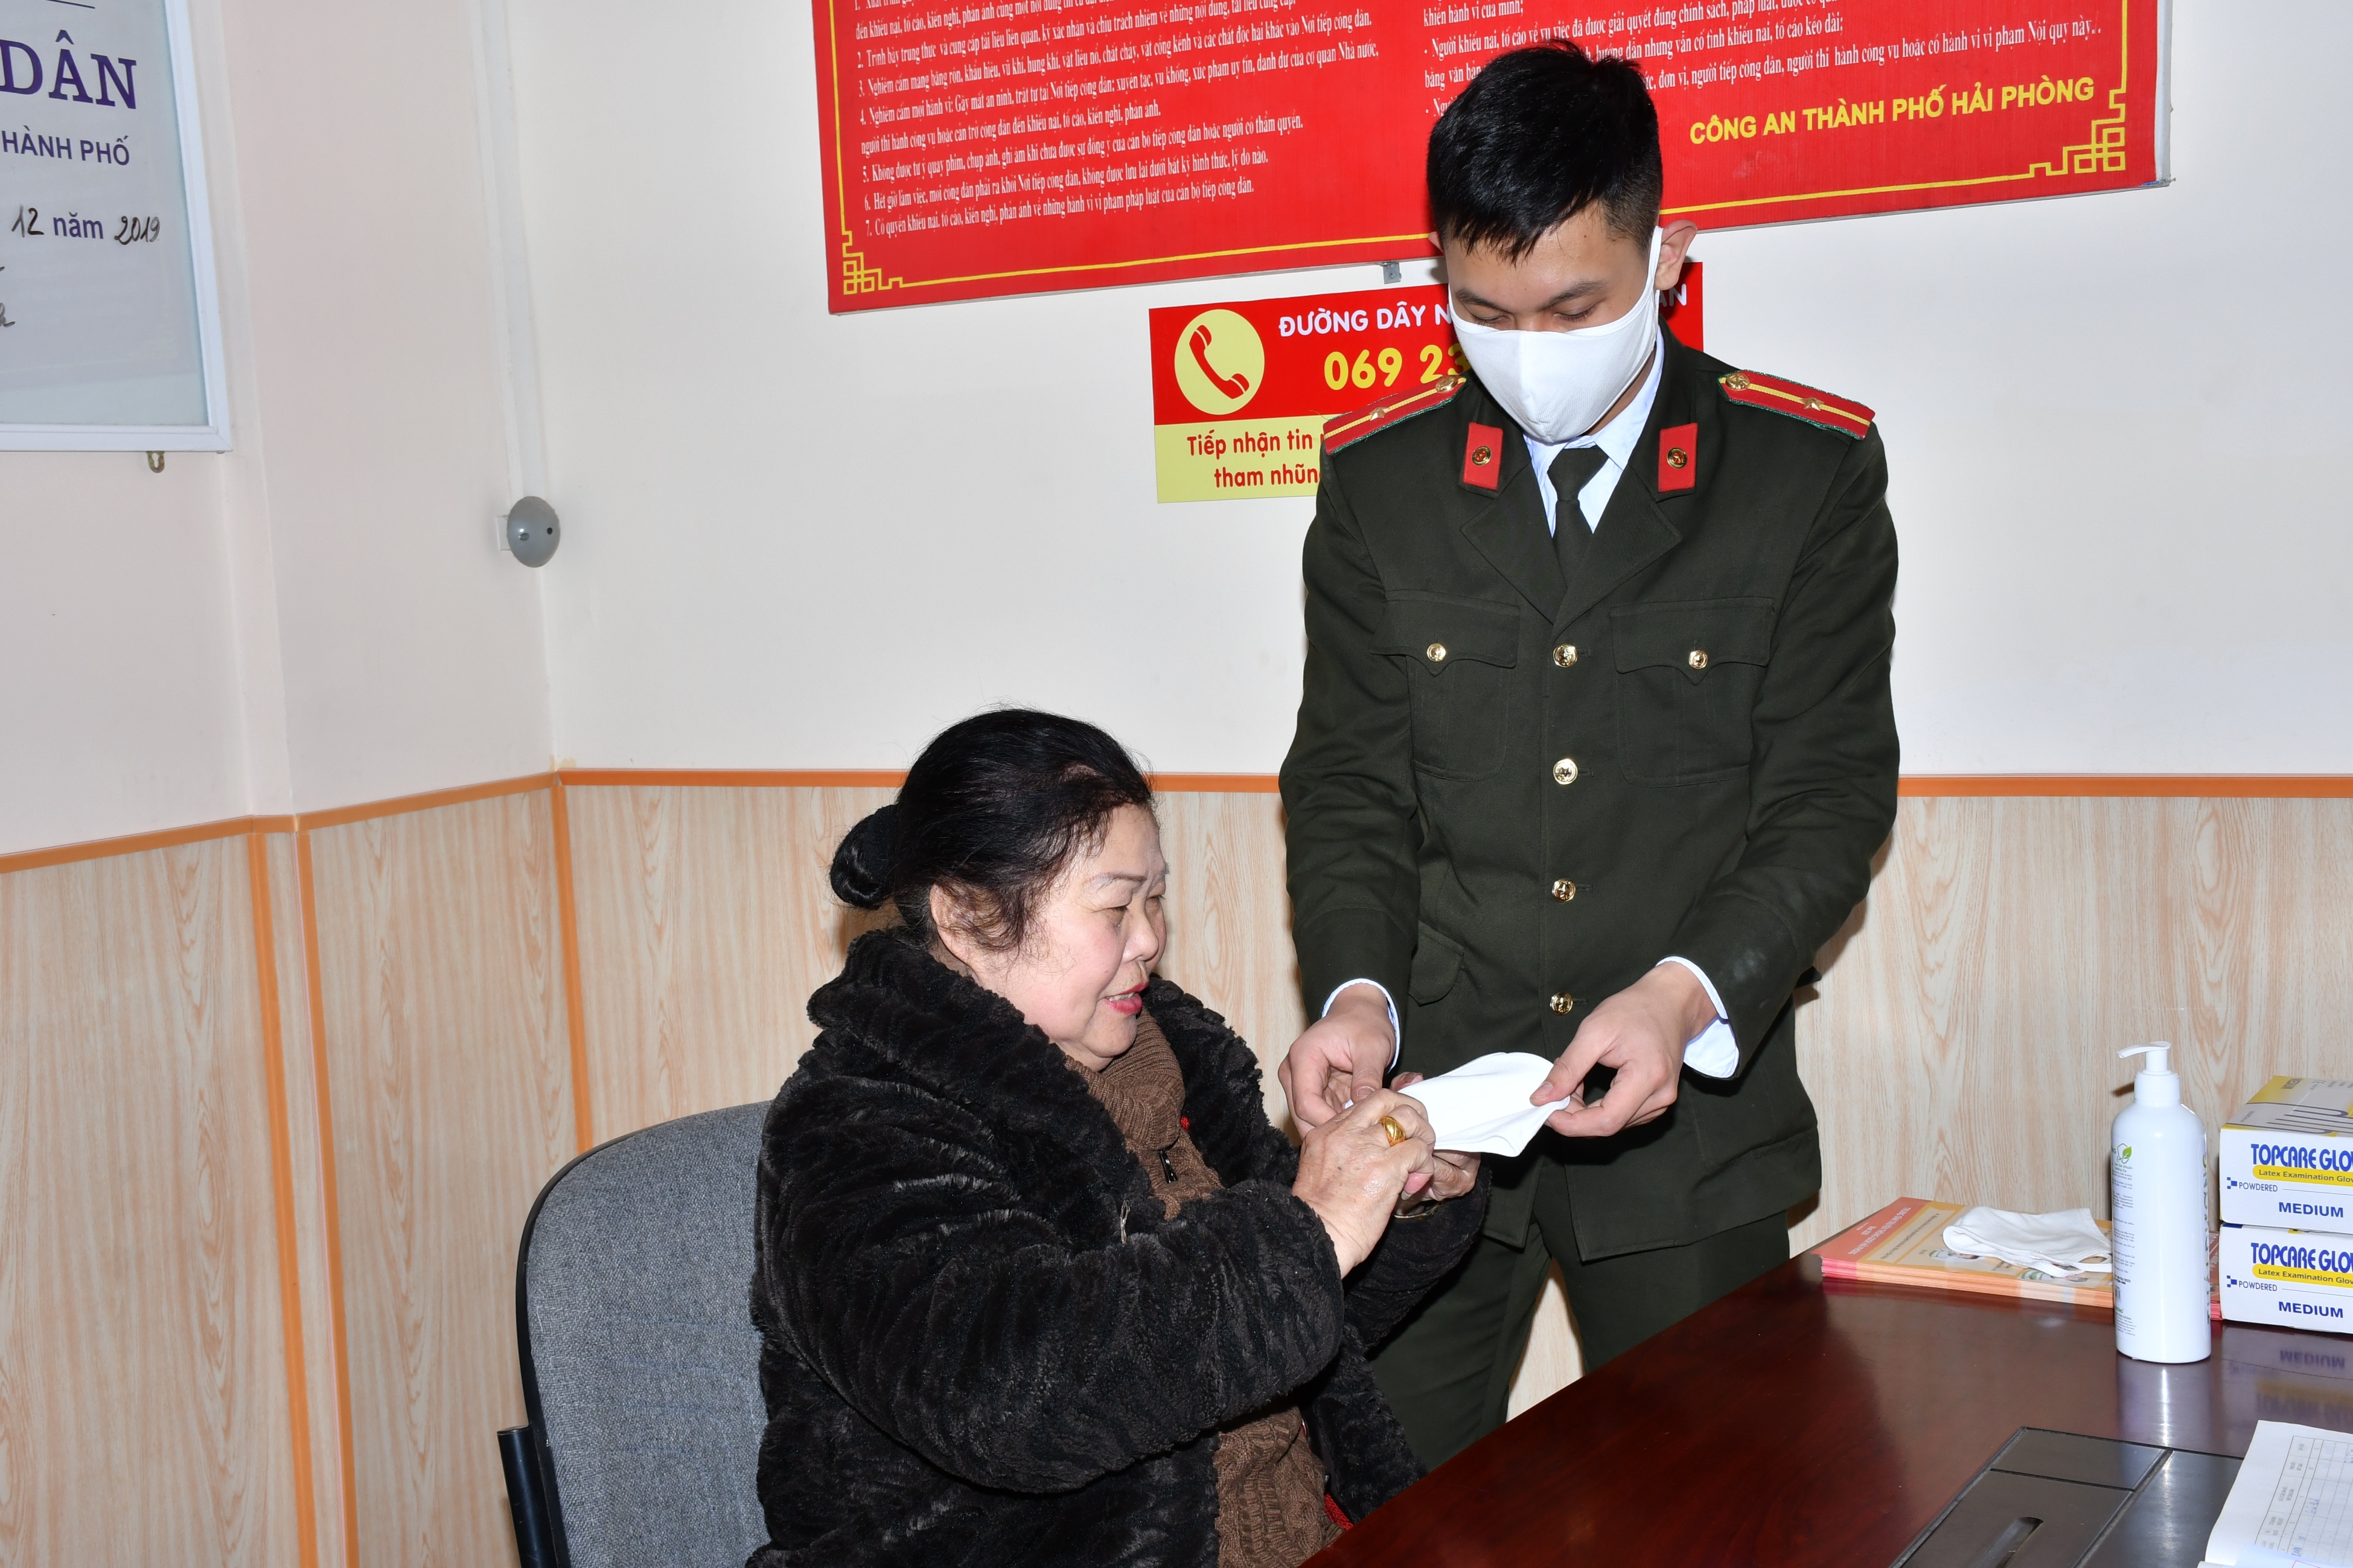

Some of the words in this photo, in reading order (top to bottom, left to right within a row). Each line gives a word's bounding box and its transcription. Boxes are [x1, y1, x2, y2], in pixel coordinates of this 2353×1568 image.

[1448, 3, 1469, 23] hành
[1471, 1, 1479, 19] vi
[1481, 0, 1496, 18] của
[1102, 45, 1118, 63] chất
[1193, 31, 1202, 49] và
[1204, 30, 1216, 48] các
[1218, 28, 1234, 46] chất
[1236, 25, 1250, 46] độc
[1251, 22, 1263, 45] hại
[1265, 20, 1283, 39] khác
[1285, 18, 1299, 36] vào
[1301, 15, 1315, 34] Nơi
[1317, 14, 1332, 36] tiếp
[1333, 12, 1353, 33] công
[1354, 8, 1371, 27] dân.
[1432, 36, 1456, 61] Người
[1458, 31, 1481, 53] khiếu
[1484, 30, 1499, 53] nại,
[1501, 29, 1510, 47] tố
[1512, 27, 1526, 46] cáo
[1528, 22, 1538, 42] về
[1572, 19, 1583, 37] đã
[1585, 17, 1606, 38] được
[1608, 11, 1624, 37] giải
[1627, 10, 1651, 35] quyết
[1653, 7, 1676, 29] đúng
[1678, 1, 1703, 23] chính
[1116, 73, 1138, 94] xuyên
[1154, 72, 1164, 85] vu
[1192, 62, 1205, 80] xúc
[1207, 60, 1229, 83] phạm
[1242, 55, 1255, 73] tín,
[1256, 52, 1276, 71] danh
[1278, 51, 1289, 72] dự
[1290, 46, 1304, 67] của
[1306, 51, 1315, 65] cơ
[1316, 49, 1336, 68] quan
[1338, 41, 1355, 60] Nhà
[1357, 39, 1378, 58] nước,
[1425, 70, 1445, 91] bằng
[1448, 67, 1464, 83] văn
[1626, 37, 1642, 60] dẫn
[1644, 38, 1673, 59] nhưng
[1675, 31, 1691, 53] vẫn
[1694, 29, 1704, 51] cố
[1706, 28, 1725, 49] tình
[1727, 23, 1753, 46] khiếu
[1755, 21, 1772, 46] nại,
[1775, 21, 1784, 39] tố
[1787, 18, 1803, 38] cáo
[1805, 15, 1822, 35] kéo
[1824, 11, 1842, 36] dài;
[1658, 69, 1676, 88] đơn
[1678, 66, 1689, 90] vị,
[1691, 62, 1717, 89] người
[1719, 61, 1737, 84] tiếp
[1739, 59, 1761, 81] công
[1763, 55, 1784, 74] dân,
[1787, 49, 1813, 76] người
[1816, 48, 1829, 68] thi
[1834, 44, 1859, 65] hành
[1862, 43, 1885, 66] công
[1902, 38, 1925, 60] hoặc
[1928, 34, 1940, 54] có
[1943, 31, 1967, 53] hành
[1971, 28, 1980, 48] vi
[1983, 27, 1992, 46] vi
[1995, 25, 2025, 52] phạm
[2028, 20, 2046, 45] Nội
[2049, 23, 2069, 45] quy
[0, 30, 136, 109] DÂN
[1690, 115, 1757, 144] CÔNG
[1763, 111, 1795, 136] AN
[1802, 98, 1885, 131] THÀNH
[1892, 84, 1947, 121] PHỐ
[1952, 82, 1993, 115] HẢI
[2001, 75, 2094, 110] PHÒNG
[1203, 123, 1220, 139] hoặc
[1222, 118, 1244, 141] người
[1245, 116, 1254, 135] có
[80, 136, 129, 165] PHỐ
[1149, 158, 1166, 177] dưới
[1167, 158, 1180, 174] bất
[1192, 153, 1209, 171] hình
[1240, 148, 1250, 165] do
[1252, 146, 1268, 164] nào.
[1042, 198, 1065, 218] những
[1067, 195, 1085, 213] hành
[1086, 194, 1093, 211] vi
[1094, 193, 1102, 210] vi
[1103, 193, 1124, 214] phạm
[1125, 190, 1144, 212] pháp
[1145, 188, 1160, 205] luật
[1161, 183, 1174, 202] của
[1176, 183, 1189, 201] cán
[1202, 180, 1216, 202] tiếp
[1218, 179, 1236, 199] công
[1237, 176, 1254, 194] dân.
[11, 205, 45, 238] 12
[53, 212, 103, 240] năm
[114, 215, 160, 245] 2019
[1279, 308, 1368, 337] ĐƯỜNG
[1377, 301, 1426, 330] DÂY
[1324, 347, 1402, 390] 069
[1187, 429, 1227, 460] Tiếp
[1233, 431, 1280, 458] nhận
[1286, 429, 1313, 450] tin
[1214, 467, 1263, 488] tham
[1271, 464, 1321, 485] nhũn
[2250, 1144, 2317, 1169] TOPCARE
[2319, 1149, 2353, 1172] GLO
[2239, 1182, 2278, 1192] POWDERED
[2283, 1171, 2334, 1181] Examination
[2279, 1202, 2343, 1218] MEDIUM
[2250, 1242, 2316, 1269] TOPCARE
[2319, 1249, 2353, 1273] GLO
[2239, 1280, 2278, 1292] POWDERED
[2282, 1271, 2333, 1283] Examination
[2278, 1301, 2343, 1318] MEDIUM
